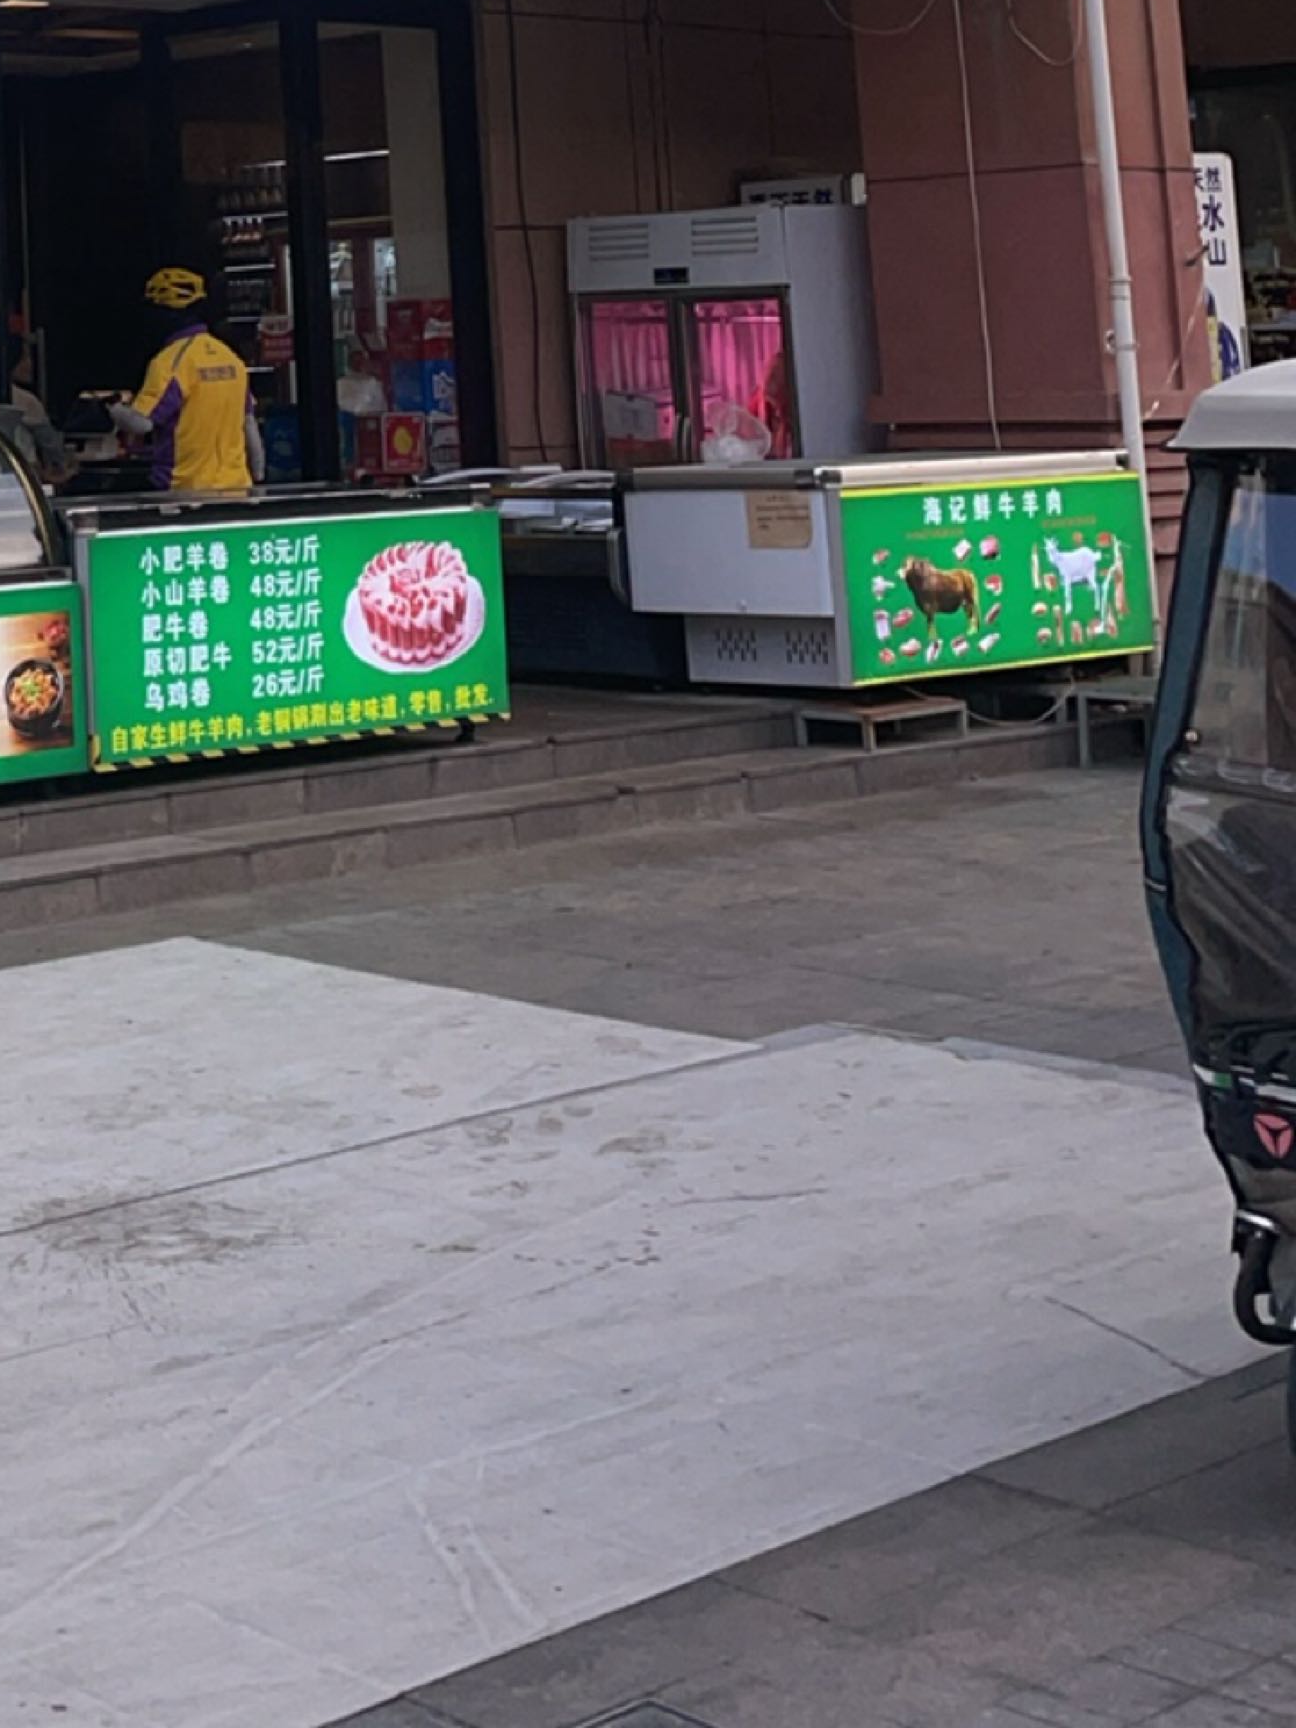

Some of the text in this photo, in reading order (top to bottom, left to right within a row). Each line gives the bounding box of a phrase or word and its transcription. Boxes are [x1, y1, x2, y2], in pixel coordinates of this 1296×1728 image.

[923, 488, 1061, 526] 海记鲜牛羊肉
[140, 534, 319, 575] 小肥羊卷 38元/斤
[141, 570, 322, 608] 小山羊卷 48元/斤
[142, 600, 322, 643] 肥牛卷 48元/斤
[143, 634, 324, 677] 原切肥牛 52元/斤
[145, 667, 324, 711] 乌鸡卷 26元/斤
